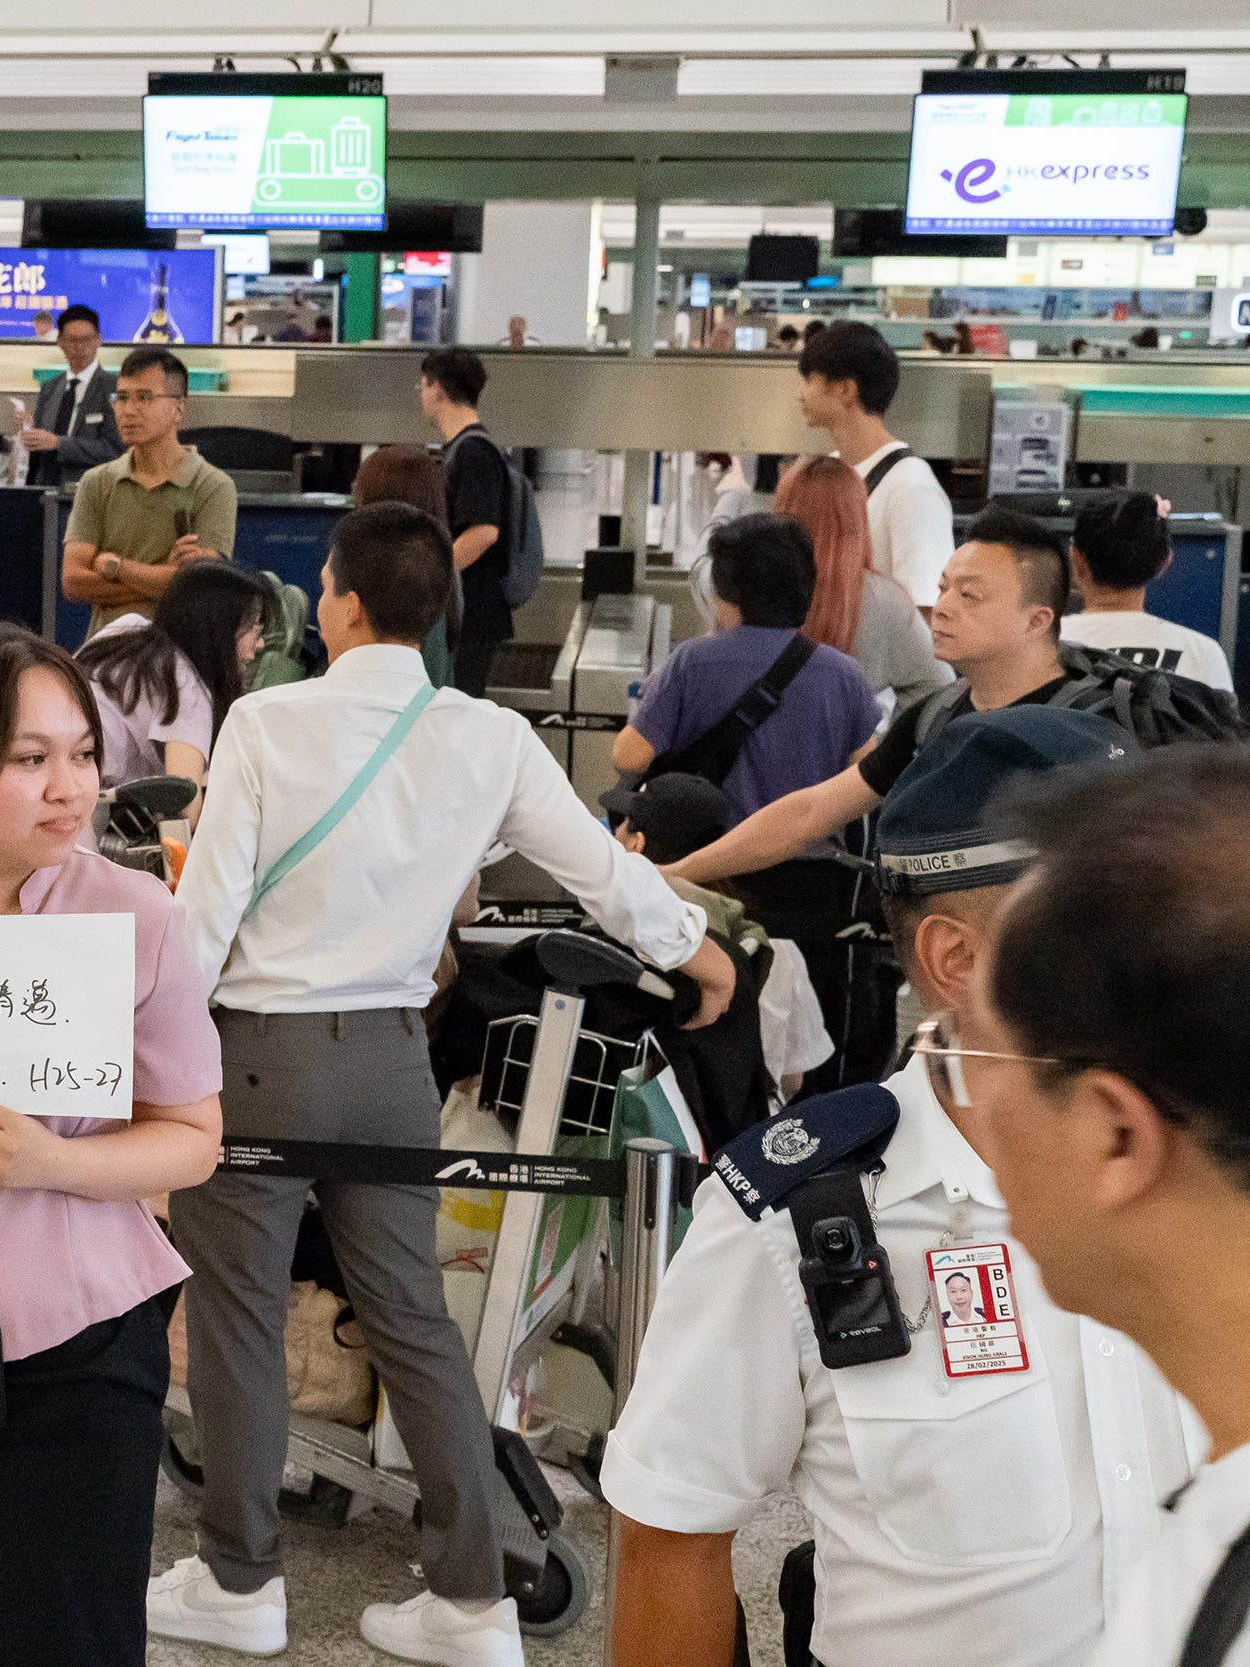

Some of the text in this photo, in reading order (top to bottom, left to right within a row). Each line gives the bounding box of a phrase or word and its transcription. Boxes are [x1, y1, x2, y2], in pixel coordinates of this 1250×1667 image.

[910, 855, 951, 872] POLICE
[30, 1057, 123, 1097] H25-27
[230, 1152, 285, 1162] INTERNATIONAL
[534, 1172, 591, 1181] INTERNATIONAL
[533, 1178, 565, 1186] AIRPORT
